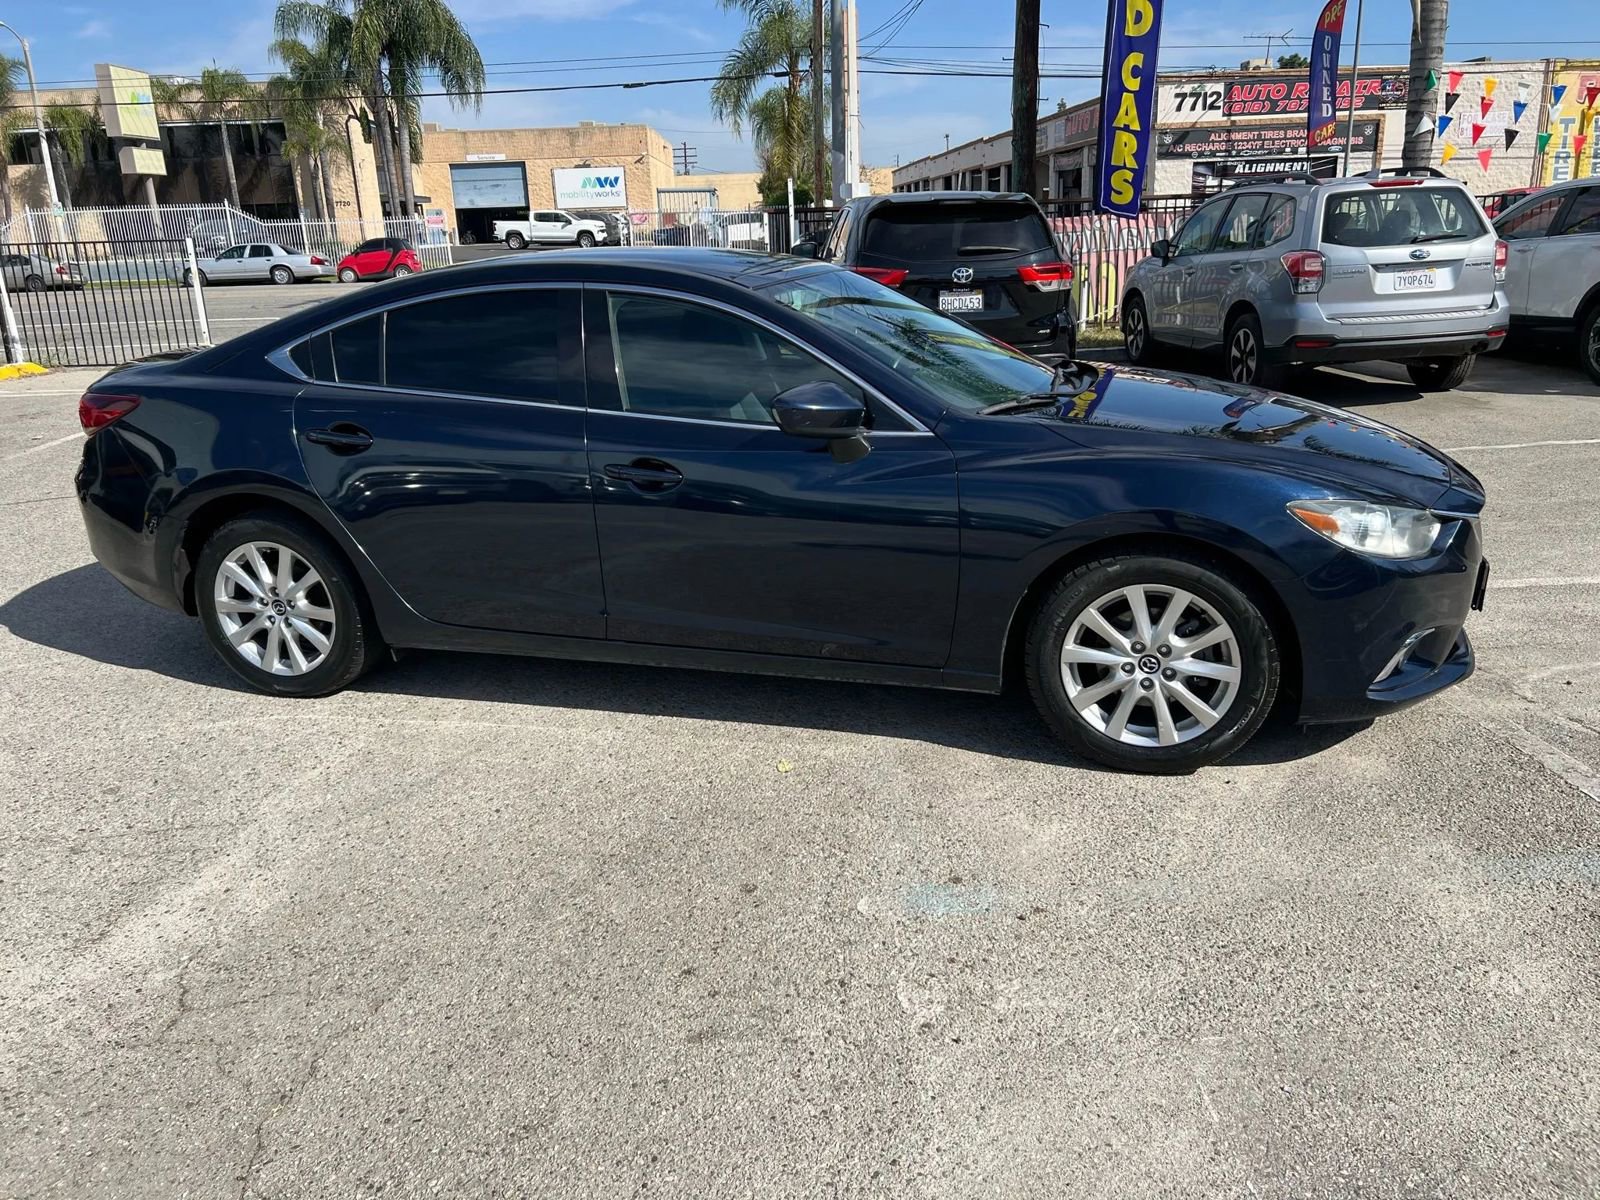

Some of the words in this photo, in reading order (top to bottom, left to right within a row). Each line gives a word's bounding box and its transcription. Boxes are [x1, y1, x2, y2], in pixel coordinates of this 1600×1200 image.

[1225, 82, 1288, 102] AUTO
[1290, 79, 1382, 99] RAIR
[1174, 91, 1222, 112] 7712
[1110, 52, 1145, 206] CARS
[1209, 131, 1259, 141] ALIGNMENT
[1260, 130, 1285, 139] TIRES
[1168, 143, 1183, 153] A/C
[1184, 141, 1232, 152] RECHARGE
[1233, 140, 1262, 150] 1234YF
[1263, 139, 1308, 149] ELECTRICA
[1317, 136, 1364, 146] AGNSIS
[1552, 117, 1577, 181] TIRE
[1234, 161, 1308, 173] ALIGNMENT
[560, 189, 621, 200] mobilityworks
[1396, 273, 1434, 288] 7YQP674
[940, 297, 981, 310] 8HCD453
